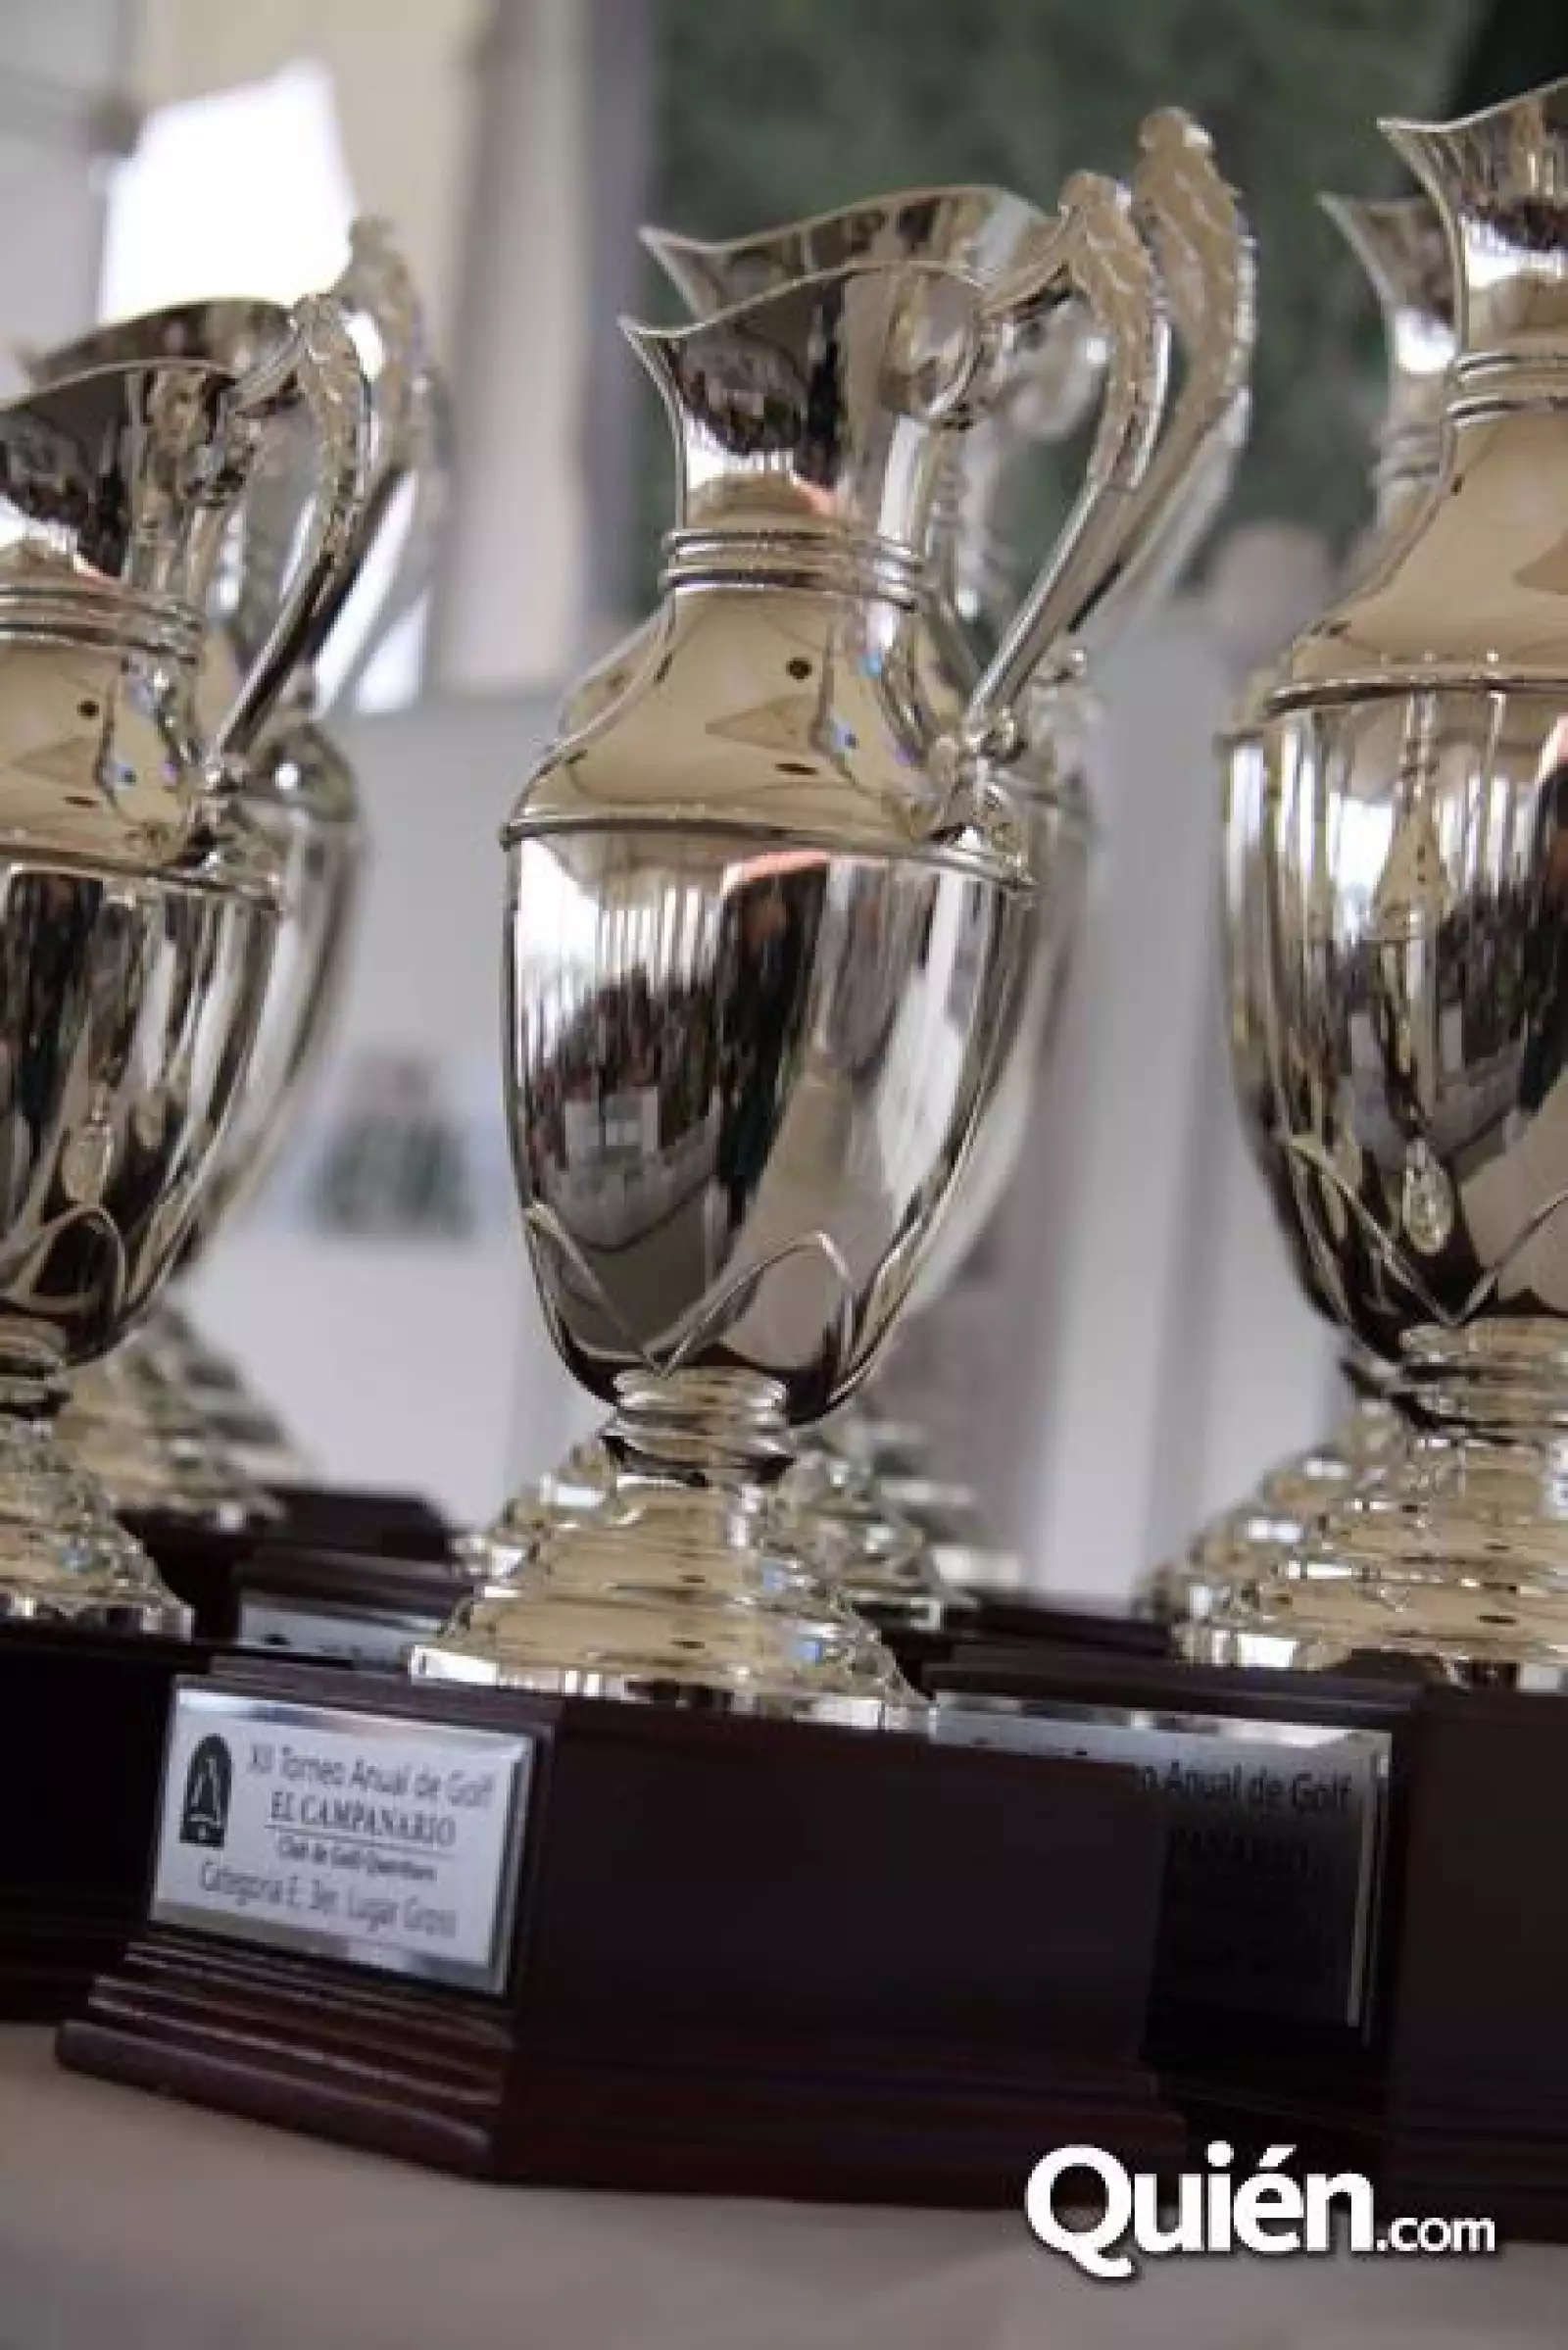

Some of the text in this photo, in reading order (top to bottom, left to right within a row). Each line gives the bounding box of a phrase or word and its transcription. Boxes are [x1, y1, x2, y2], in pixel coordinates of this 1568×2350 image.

[351, 1756, 409, 1795] Anual
[415, 1767, 442, 1800] de
[1250, 1765, 1285, 1805] de
[1291, 1767, 1352, 1812] Golf
[270, 1790, 295, 1821] EL
